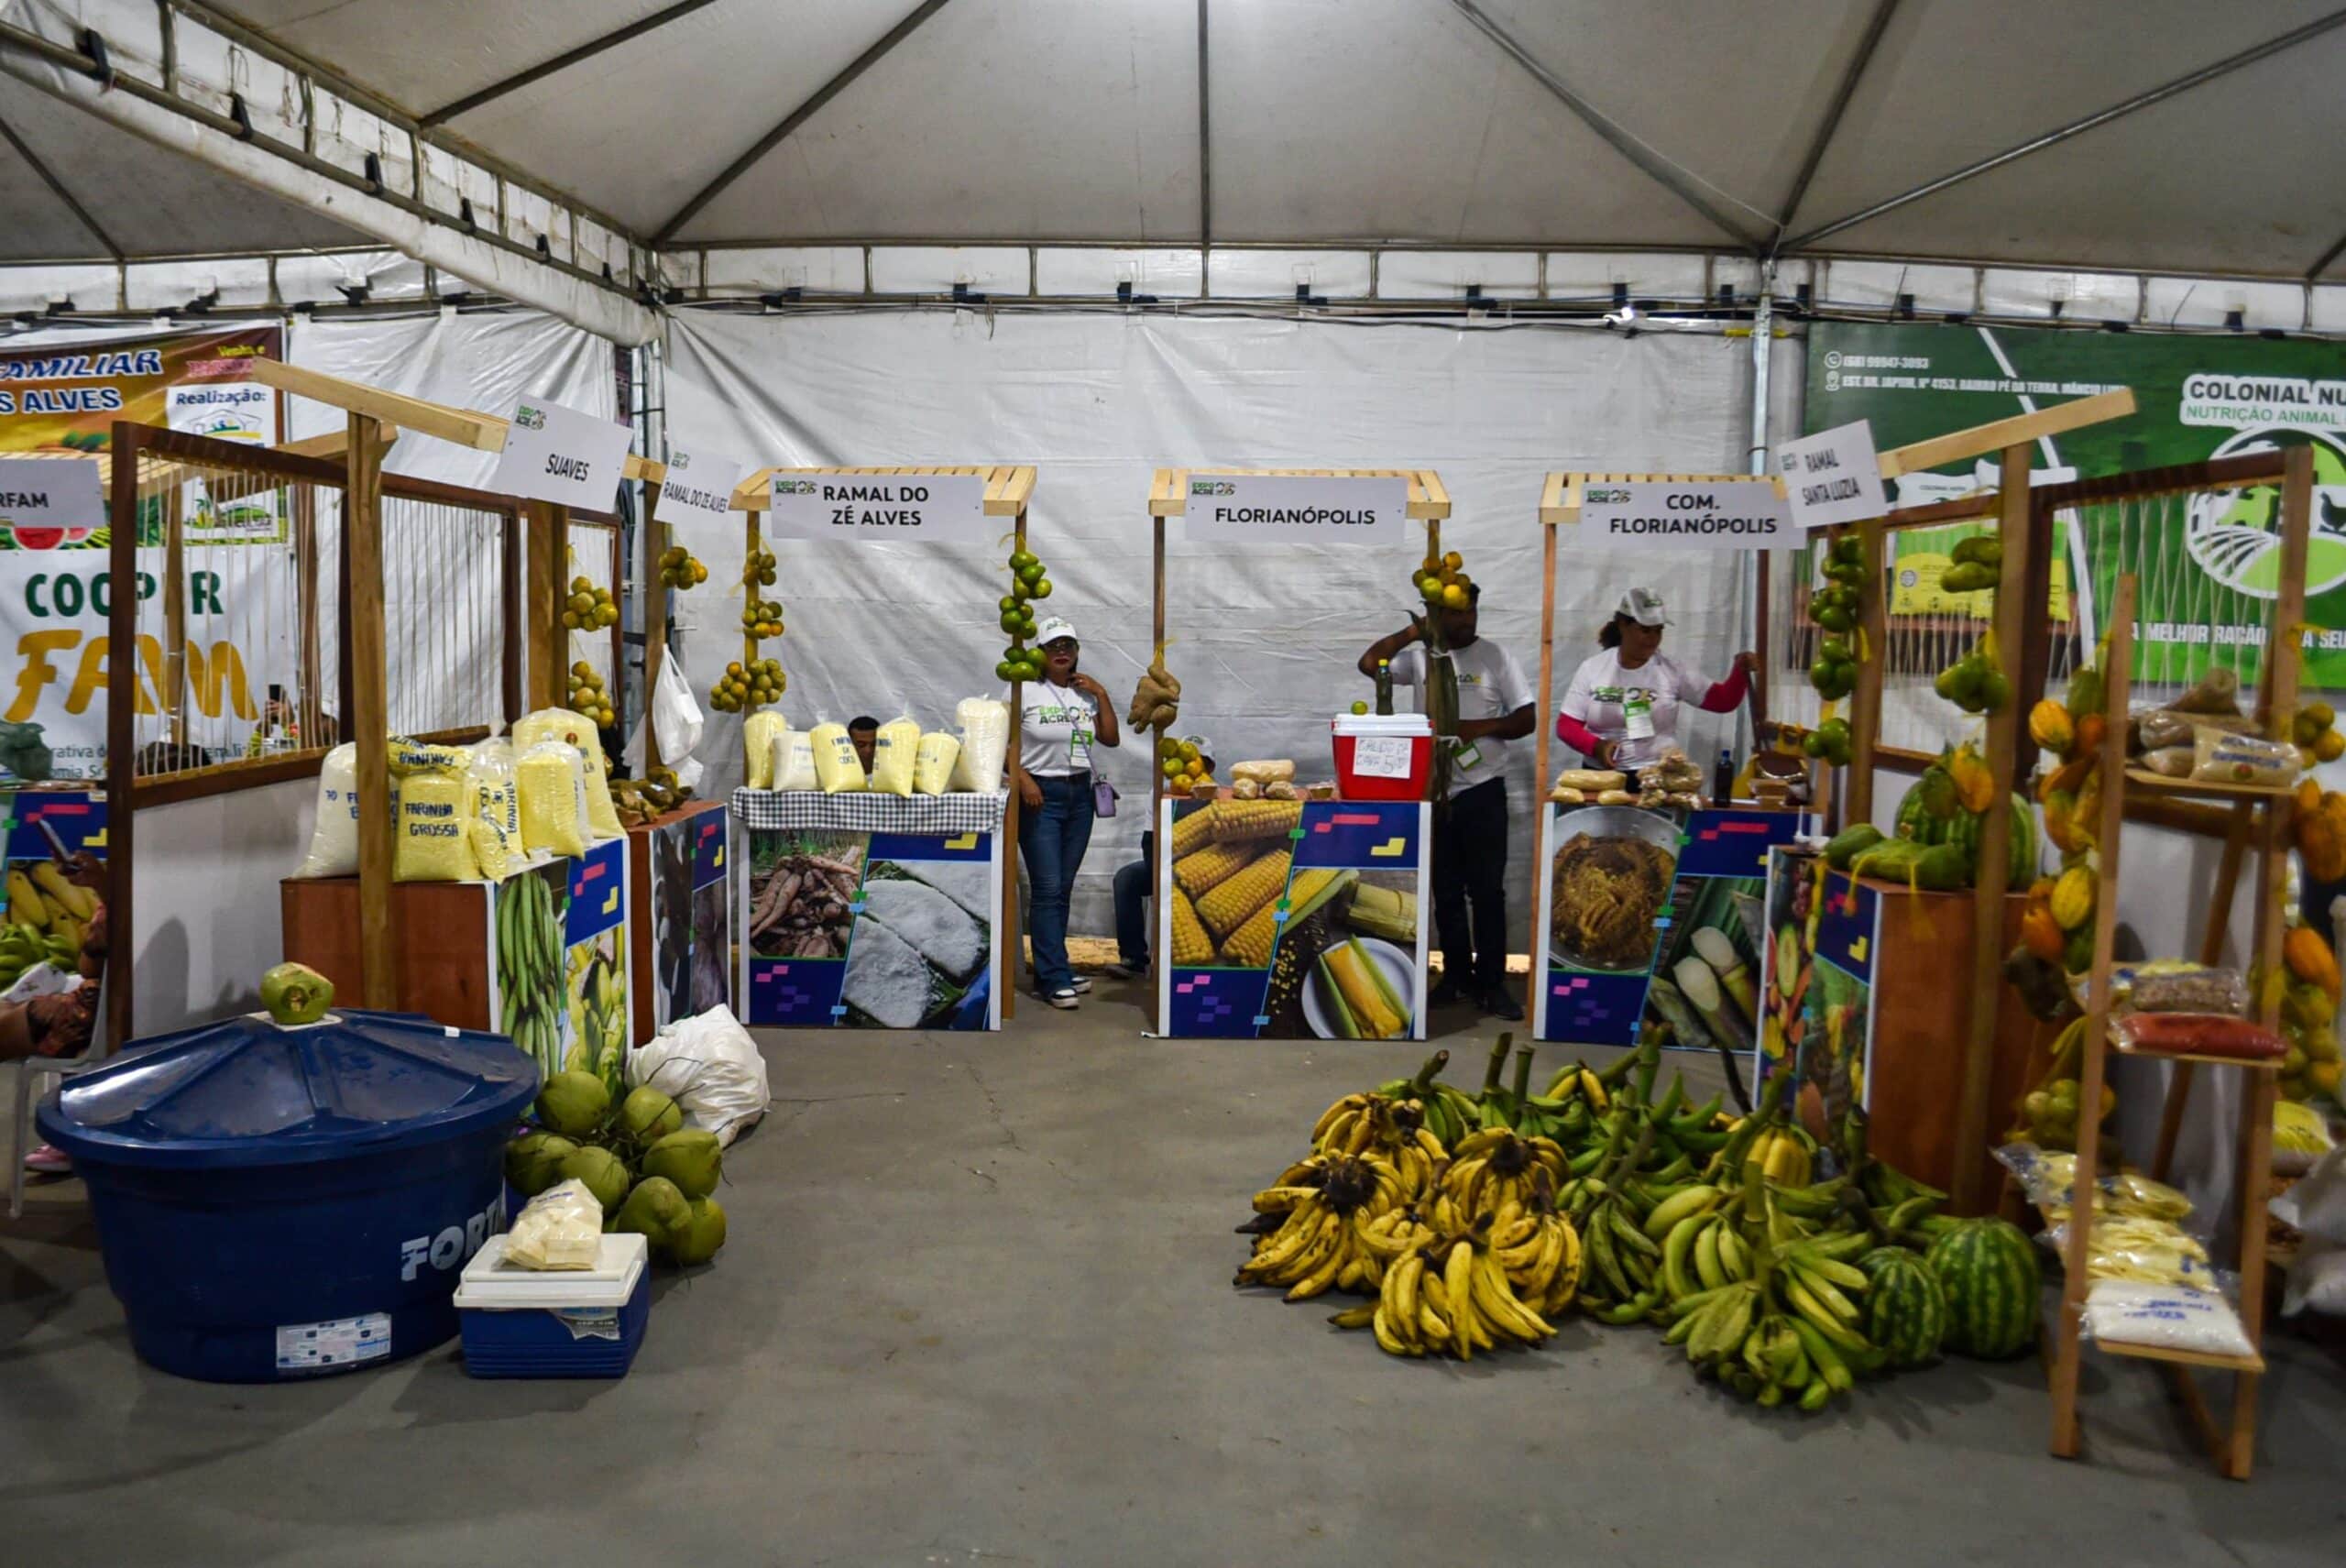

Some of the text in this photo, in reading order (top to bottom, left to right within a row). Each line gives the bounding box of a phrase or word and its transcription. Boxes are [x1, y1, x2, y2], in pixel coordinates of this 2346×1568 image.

[0, 350, 162, 378] AMILIAR
[24, 388, 123, 412] ALVES
[175, 389, 267, 406] Realização:
[2189, 379, 2310, 404] COLONIAL
[2187, 404, 2340, 425] NUTRIÇÃO ANIMAL
[545, 454, 589, 482] SUAVES
[1804, 448, 1839, 473] RAMAL
[823, 486, 929, 502] RAMAL DO
[1666, 494, 1720, 510] COM.
[1802, 477, 1861, 507] SANTA LUZIA
[831, 505, 922, 525] ZÉ ALVES
[1215, 506, 1376, 524] FLORIANÓPOLIS
[1609, 514, 1777, 533] FLORIANÓPOLIS
[25, 571, 224, 618] COOPR
[2147, 622, 2209, 642] MELHOR
[405, 803, 453, 817] FARINHA
[409, 823, 459, 837] GROSSA
